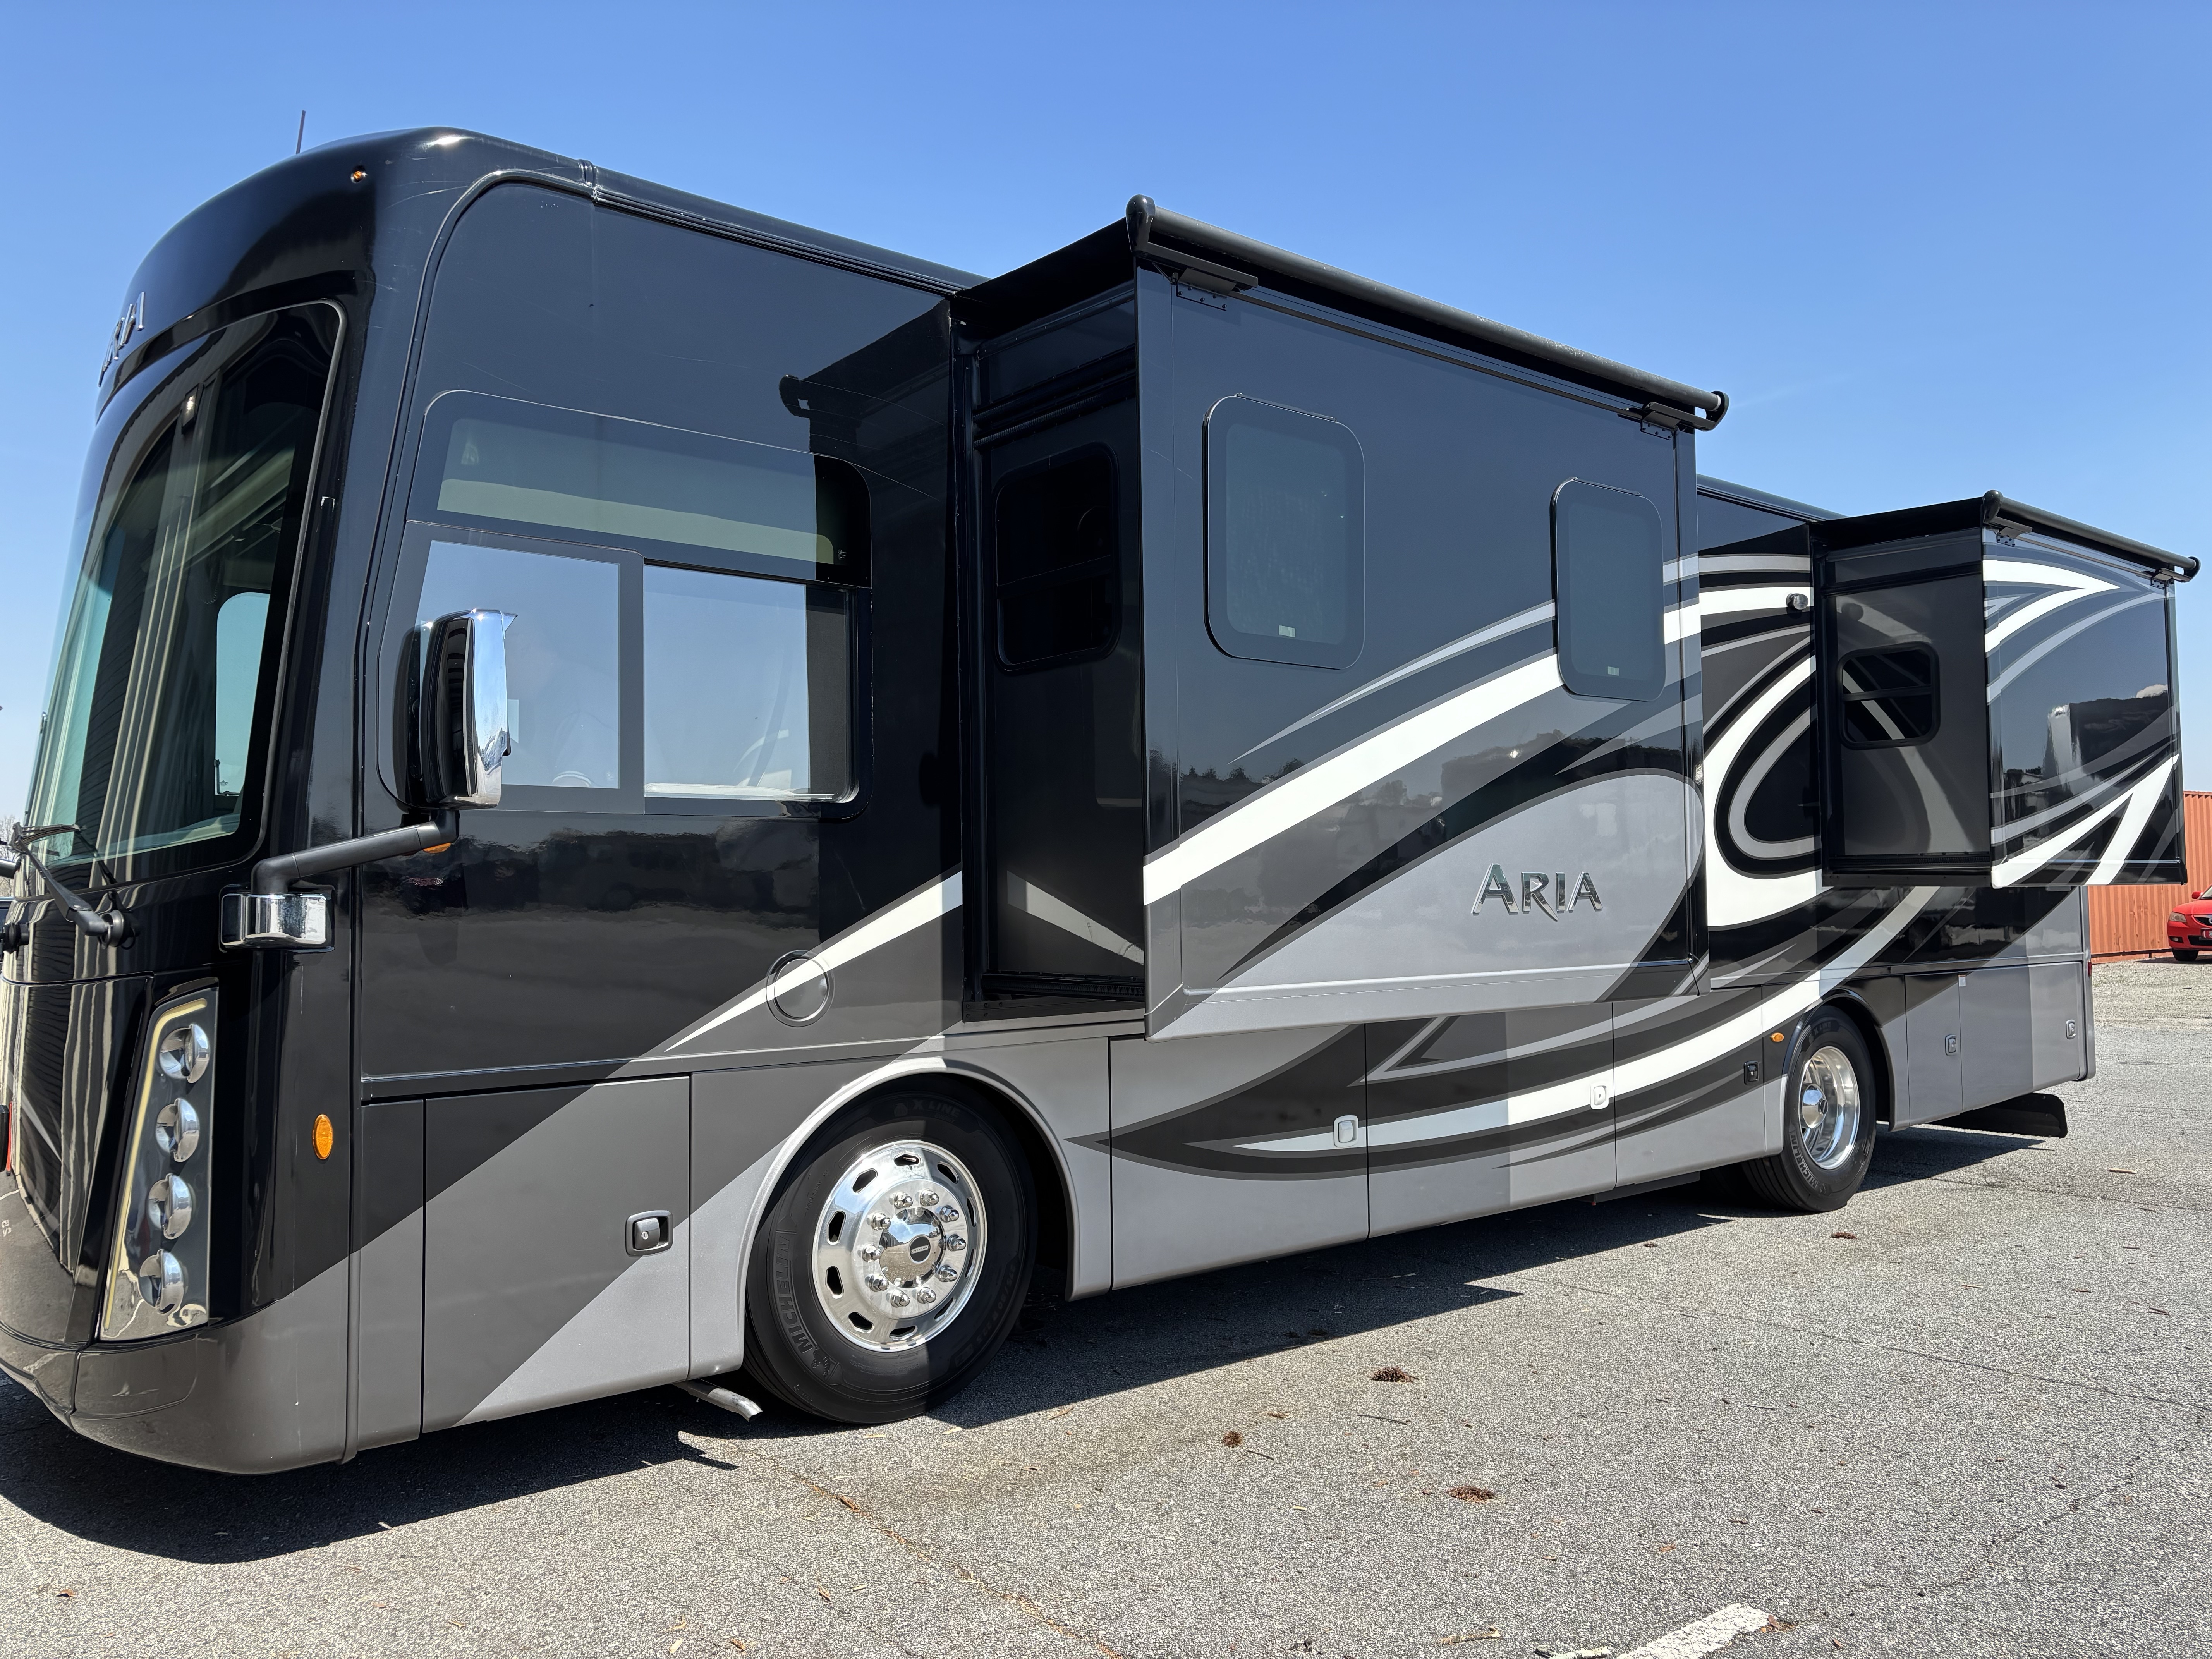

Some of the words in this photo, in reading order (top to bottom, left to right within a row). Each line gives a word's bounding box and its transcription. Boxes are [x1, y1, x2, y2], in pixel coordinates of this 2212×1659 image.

[1471, 863, 1603, 922] ARIA
[912, 1099, 924, 1111] X
[928, 1100, 961, 1118] LINE
[1790, 1135, 1819, 1189] MICHELIN
[776, 1235, 814, 1354] MICHELIN
